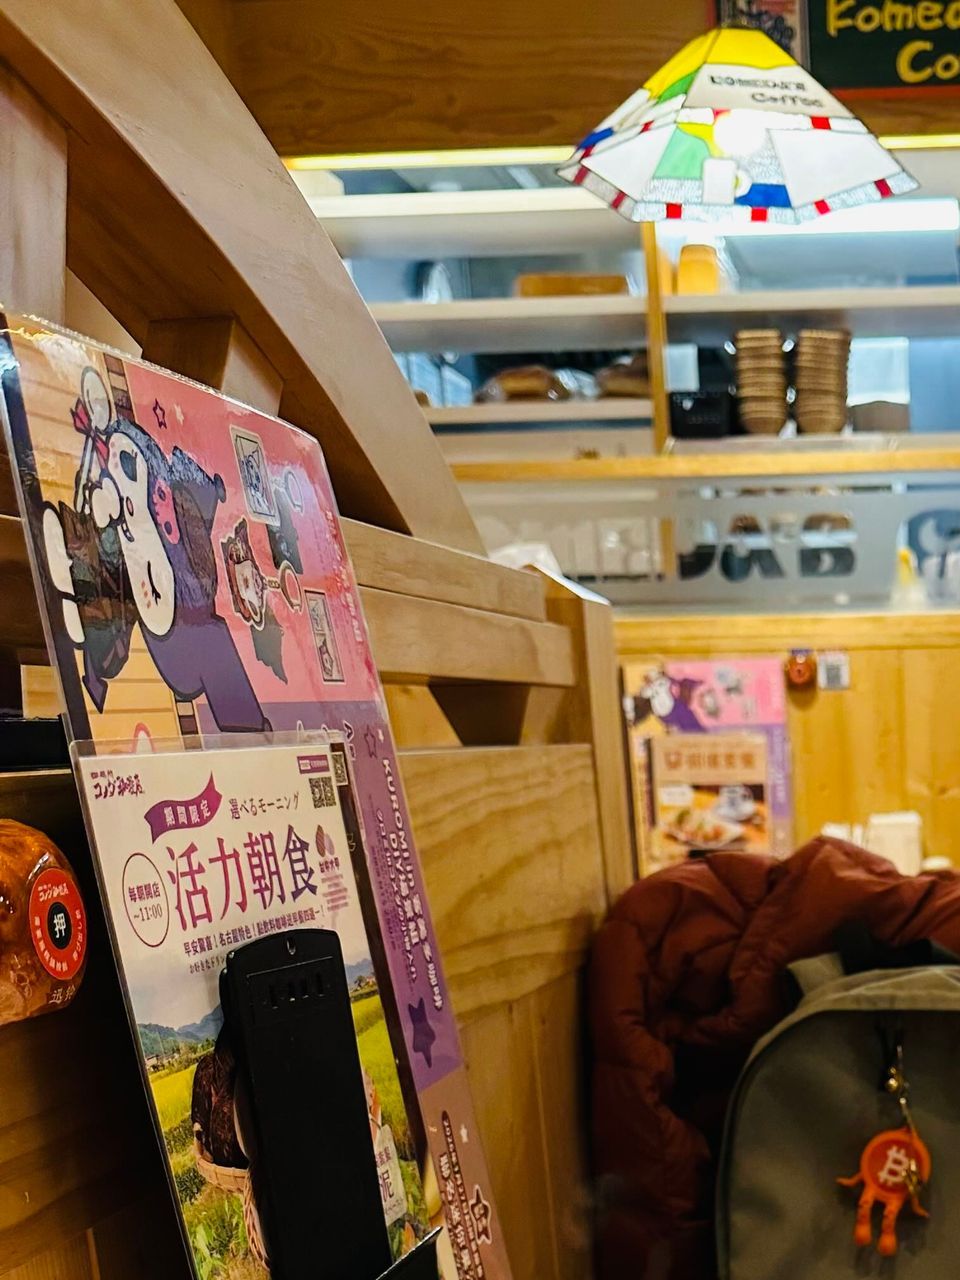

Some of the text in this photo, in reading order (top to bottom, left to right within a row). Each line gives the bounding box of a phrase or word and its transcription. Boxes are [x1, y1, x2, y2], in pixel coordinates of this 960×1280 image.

[164, 799, 211, 827] 期間限定
[229, 792, 299, 820] 選べるモーニング
[382, 758, 409, 858] KUROMI
[166, 824, 318, 932] 活力朝食
[54, 913, 66, 938] 押
